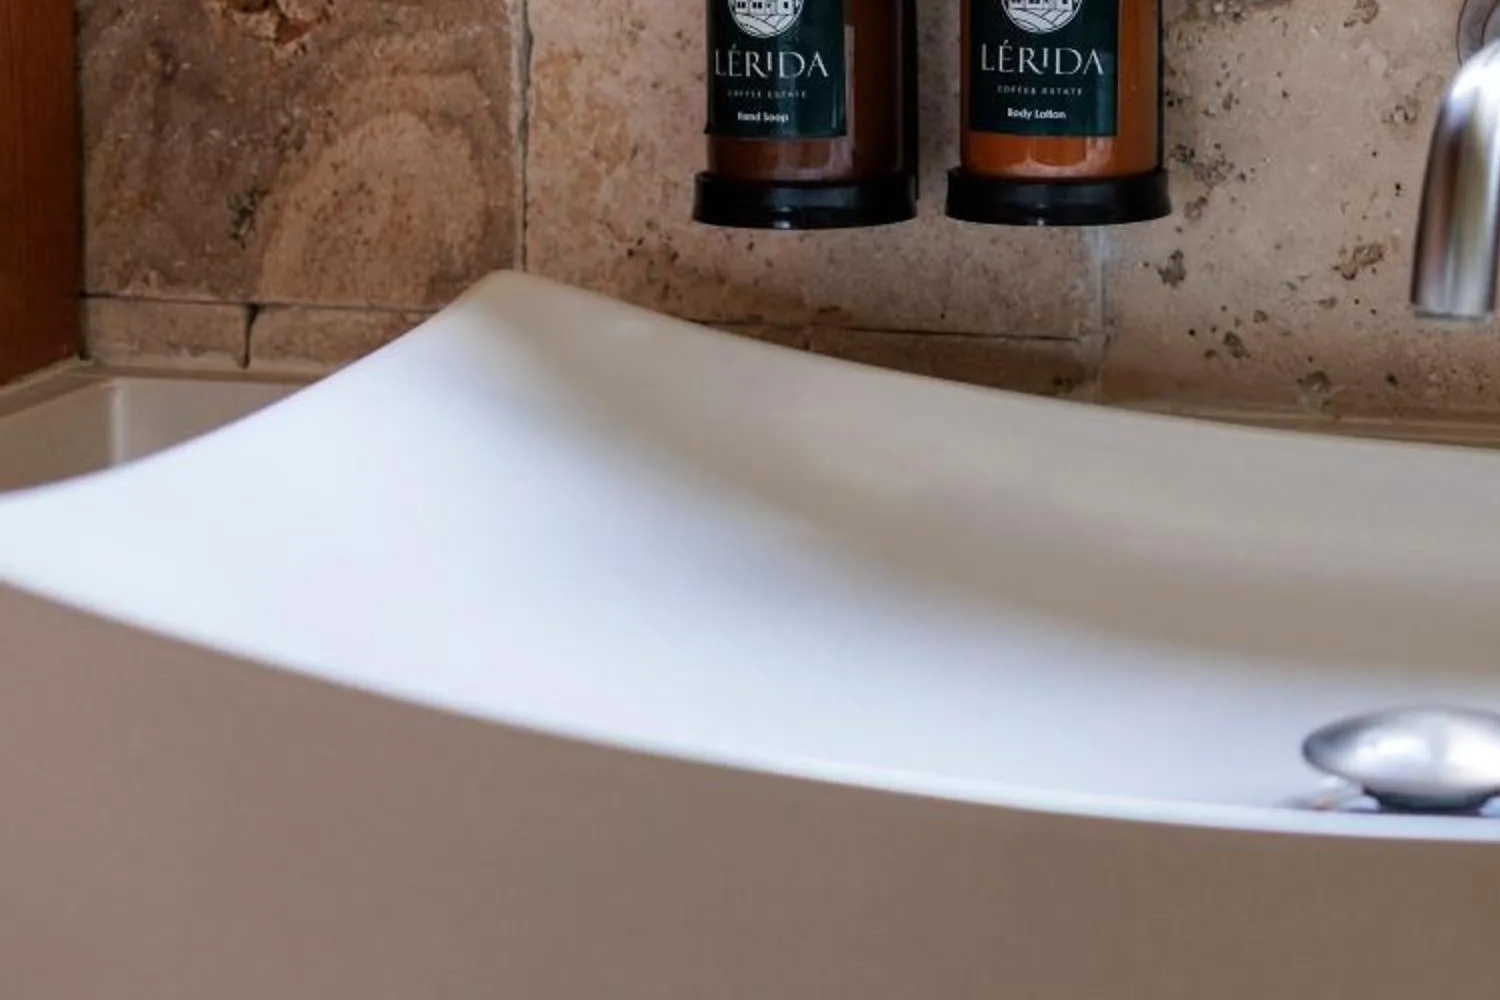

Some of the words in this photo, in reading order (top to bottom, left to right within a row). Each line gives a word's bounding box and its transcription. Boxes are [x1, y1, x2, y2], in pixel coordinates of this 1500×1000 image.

[715, 43, 829, 78] LÉRIDA
[981, 39, 1104, 75] LÉRIDA
[997, 85, 1036, 95] COFFEE
[1007, 107, 1033, 120] Body
[1035, 109, 1067, 120] Lotion
